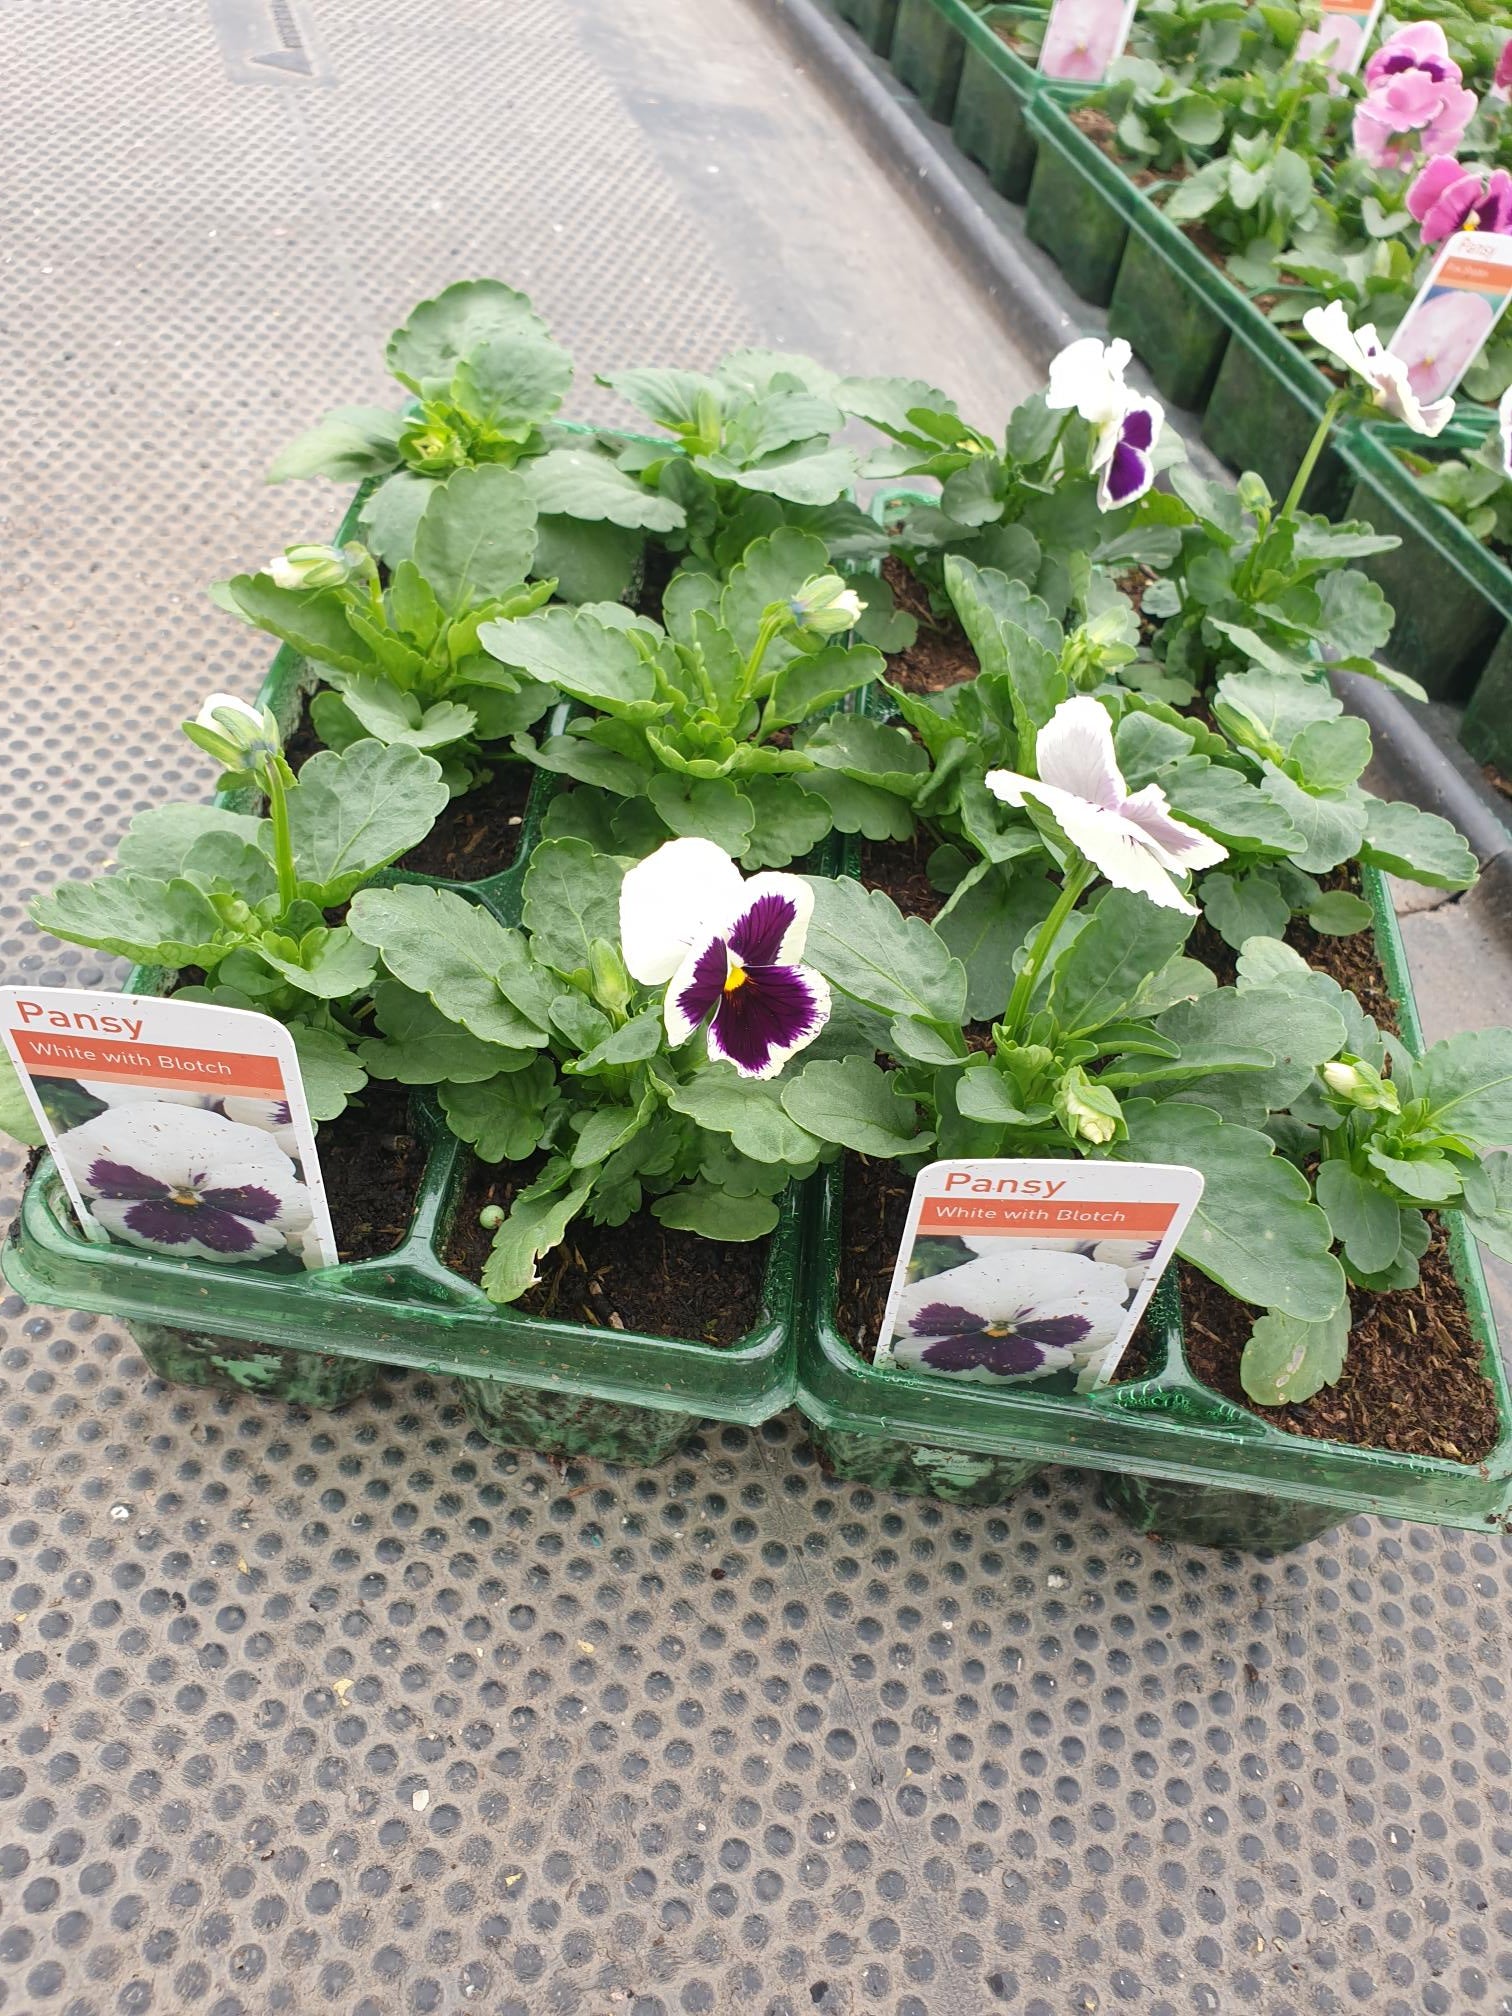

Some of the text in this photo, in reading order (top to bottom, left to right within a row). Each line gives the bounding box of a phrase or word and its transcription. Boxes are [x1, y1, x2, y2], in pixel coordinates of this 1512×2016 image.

[16, 1000, 143, 1040] Pansy
[29, 1041, 232, 1075] White with Blotch
[944, 1172, 1067, 1199] Pansy
[936, 1206, 1126, 1222] White with Blotch
